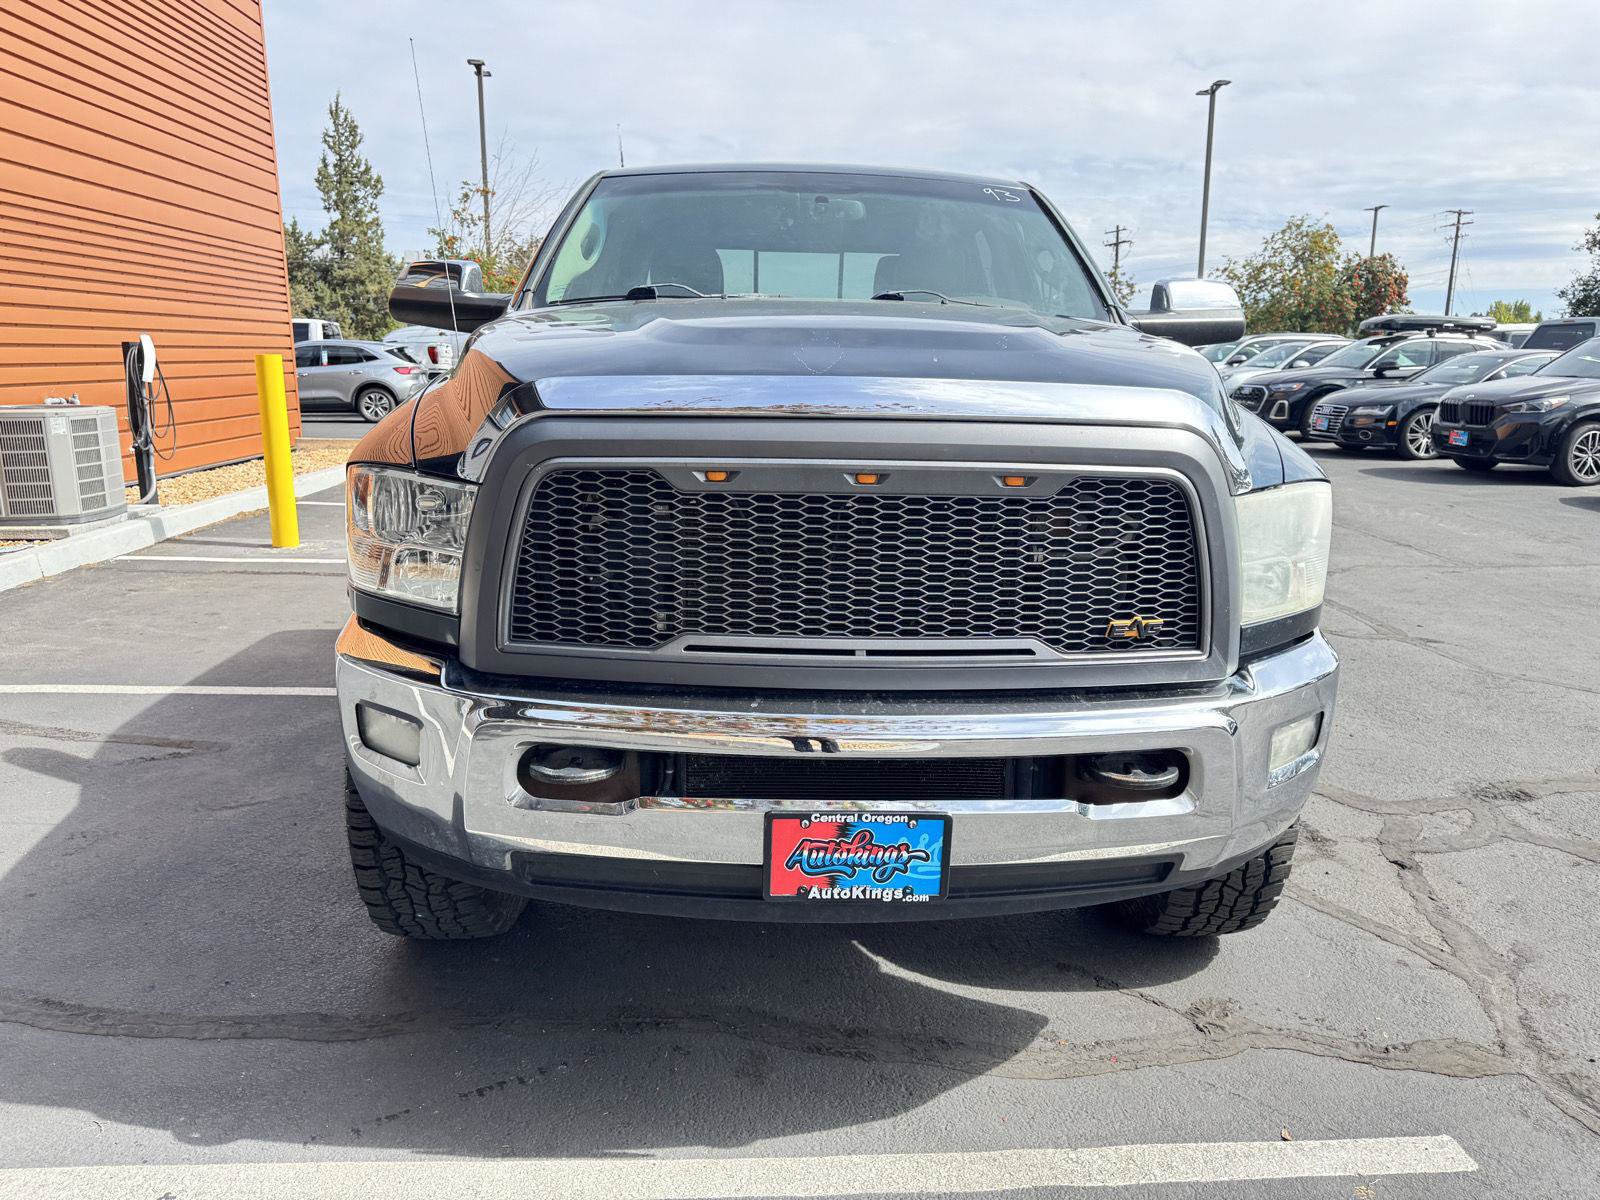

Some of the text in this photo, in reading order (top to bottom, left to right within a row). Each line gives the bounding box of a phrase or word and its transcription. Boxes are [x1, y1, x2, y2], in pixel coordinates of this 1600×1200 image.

[983, 188, 1020, 202] 93
[811, 813, 908, 825] Central Oregon
[808, 885, 929, 902] AutoKings.com
